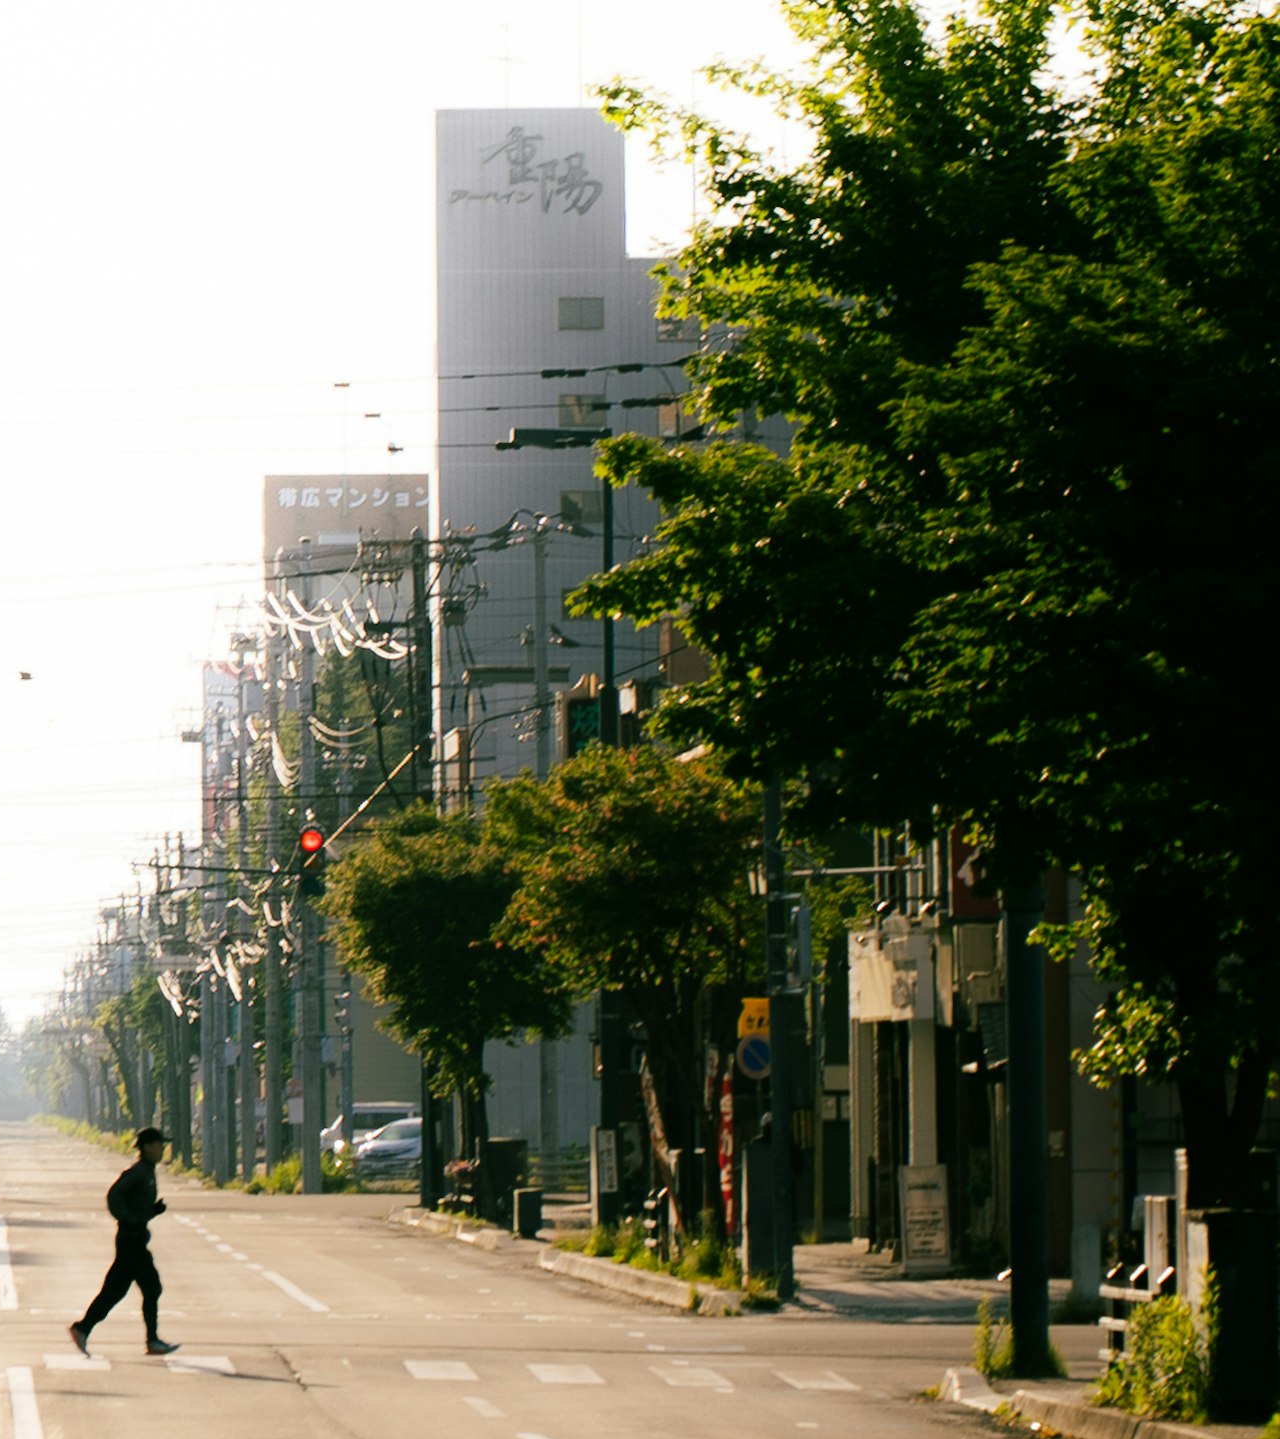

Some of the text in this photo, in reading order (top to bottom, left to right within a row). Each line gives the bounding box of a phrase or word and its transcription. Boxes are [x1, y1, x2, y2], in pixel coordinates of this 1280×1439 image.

[277, 486, 429, 508] 帯広マンション
